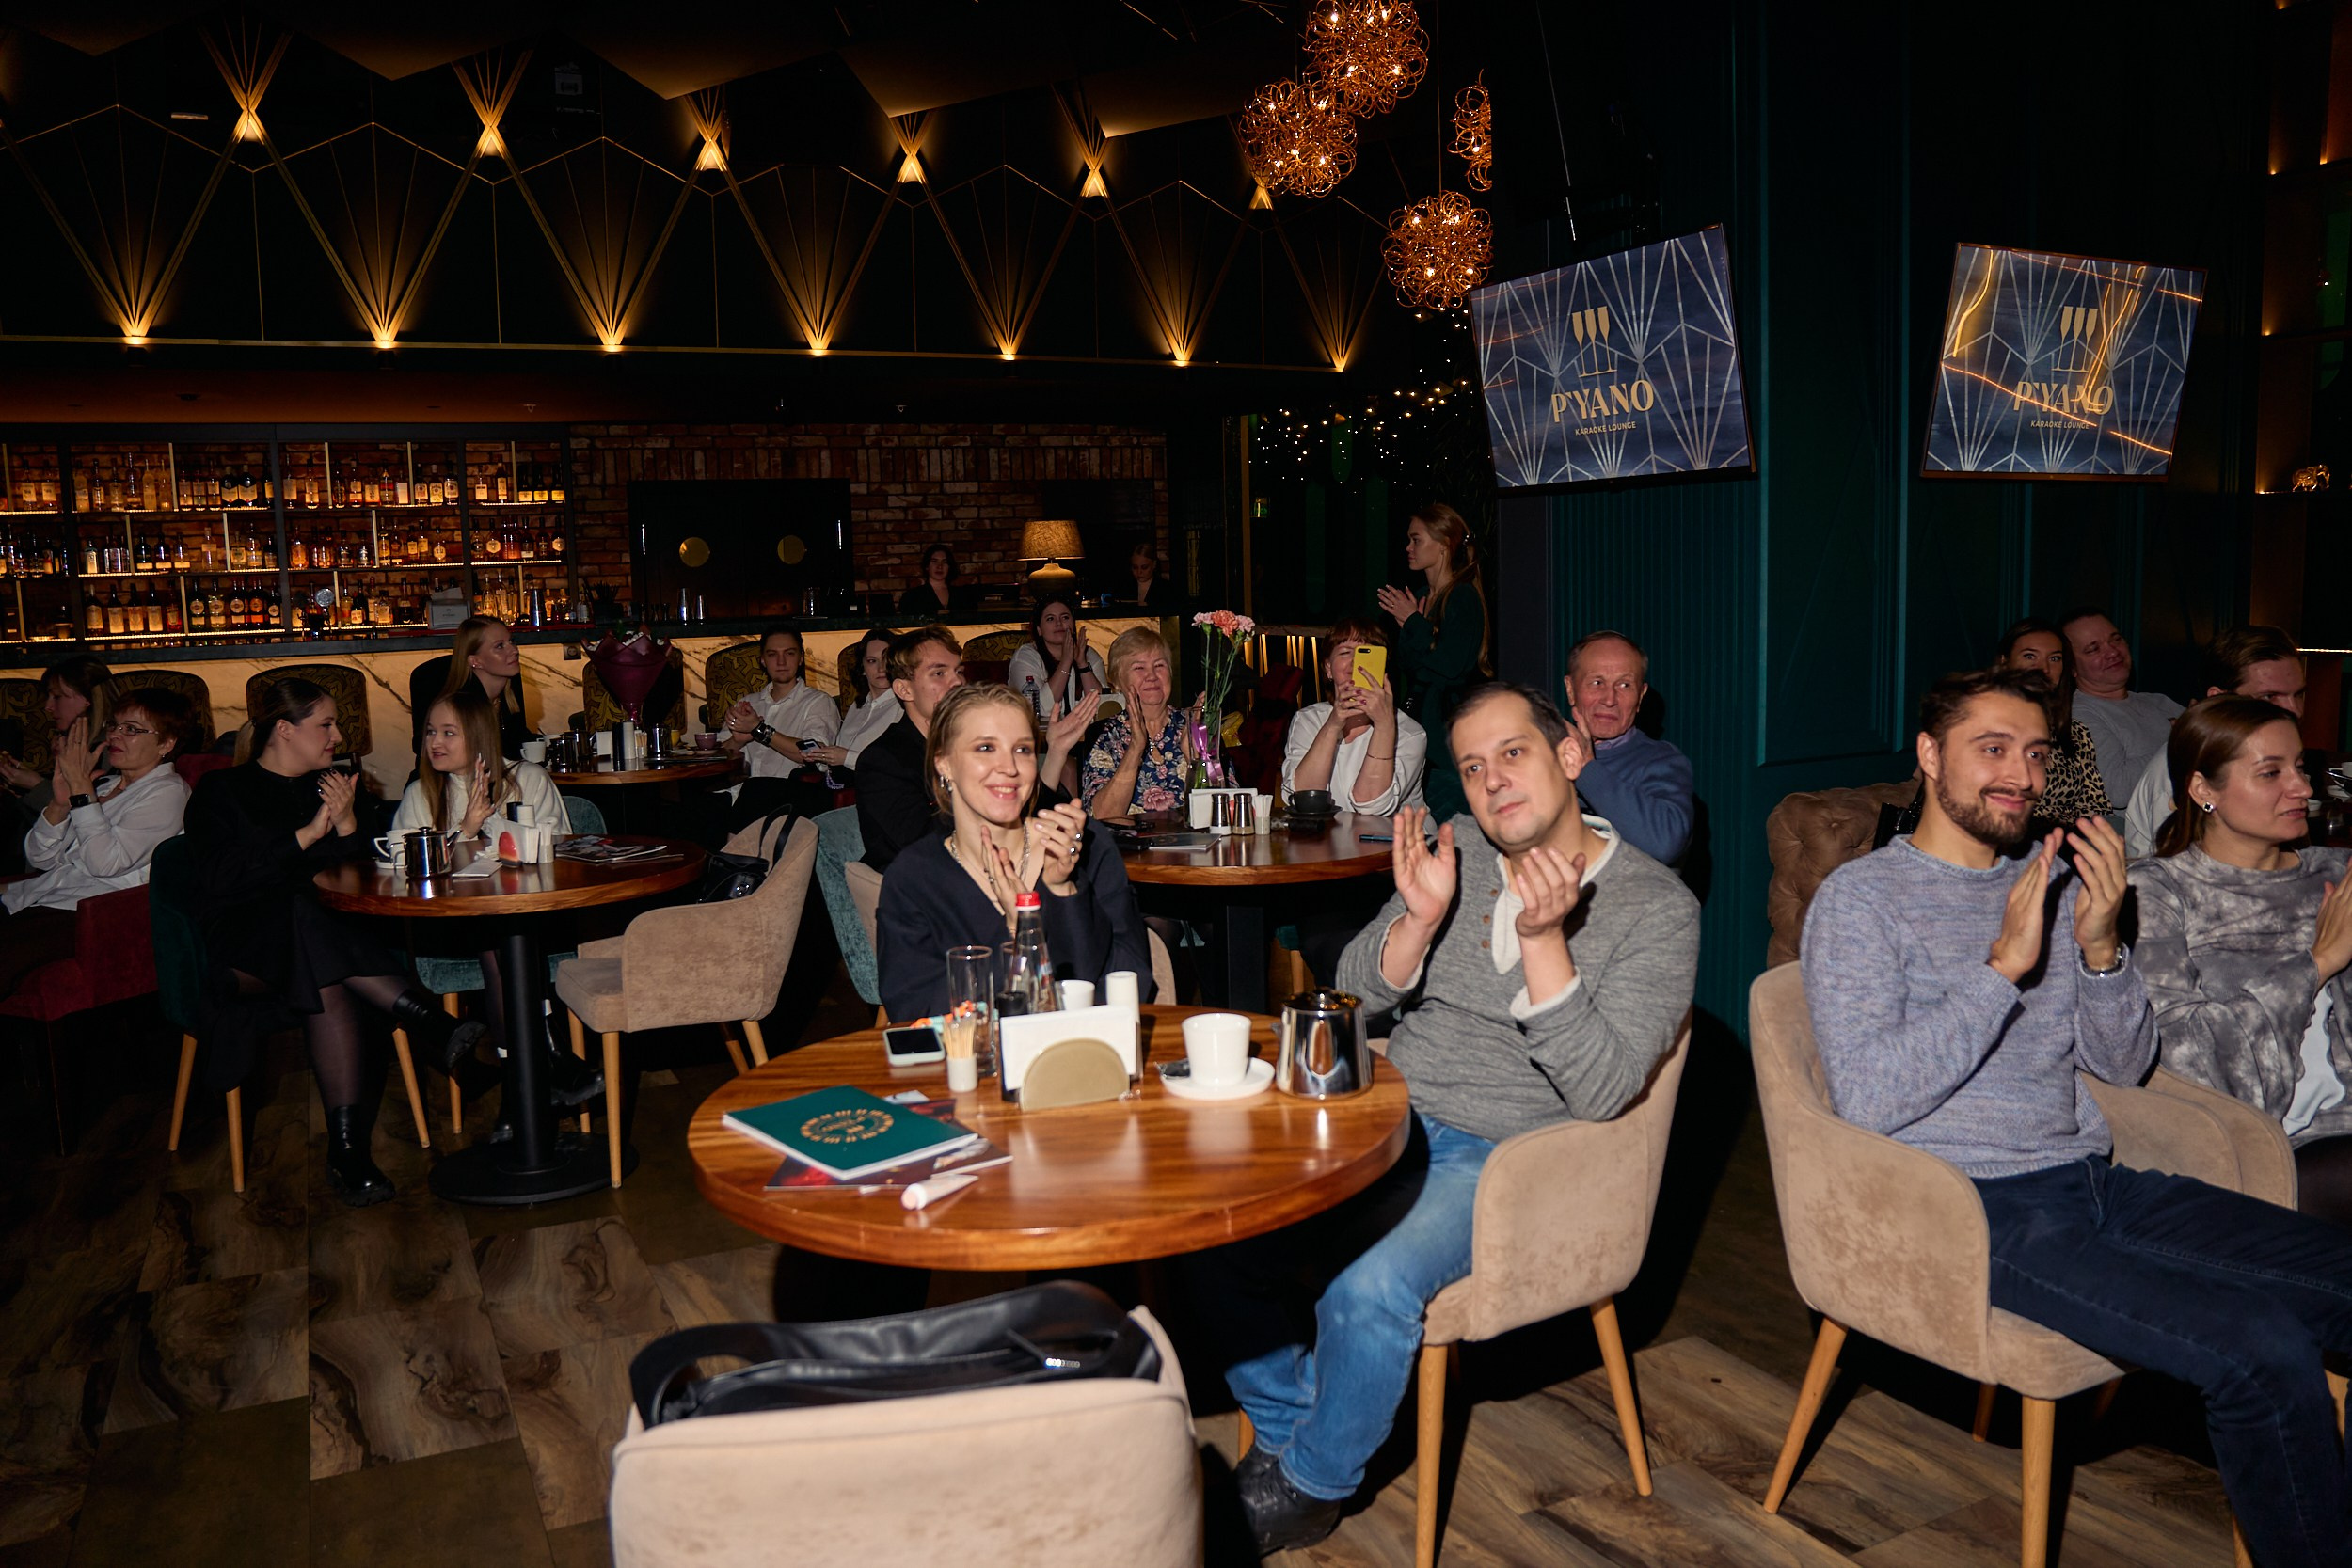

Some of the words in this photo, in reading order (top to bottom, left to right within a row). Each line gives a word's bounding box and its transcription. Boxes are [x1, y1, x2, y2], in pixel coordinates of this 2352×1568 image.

[1575, 424, 1607, 436] KARAOKE
[1608, 421, 1636, 432] LOUNGE
[2063, 421, 2090, 430] LOUNGE
